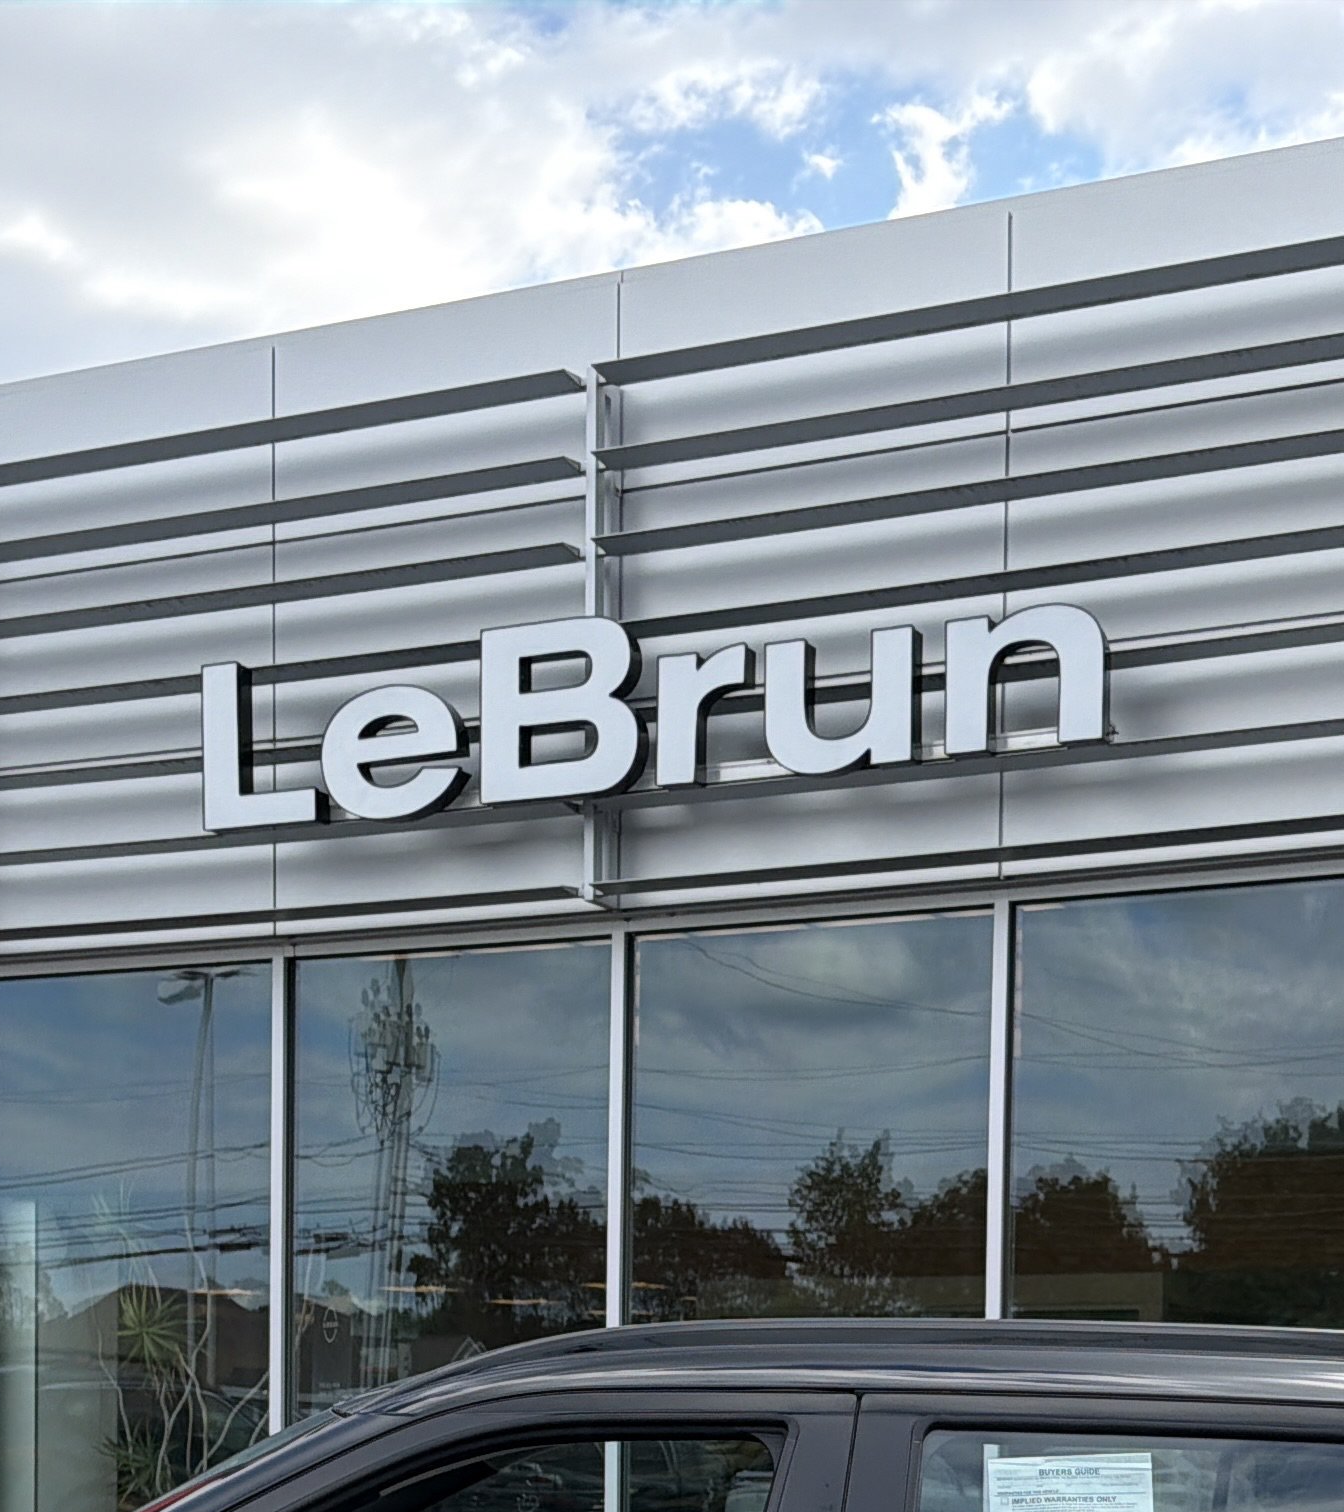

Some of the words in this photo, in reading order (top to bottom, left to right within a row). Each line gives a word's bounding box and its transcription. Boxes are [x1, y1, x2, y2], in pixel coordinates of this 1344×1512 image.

[201, 603, 1112, 834] LeBrun
[1039, 1468, 1072, 1477] BUYERS
[1012, 1497, 1042, 1505] IMPLIED
[1044, 1496, 1094, 1504] WARRANTIES
